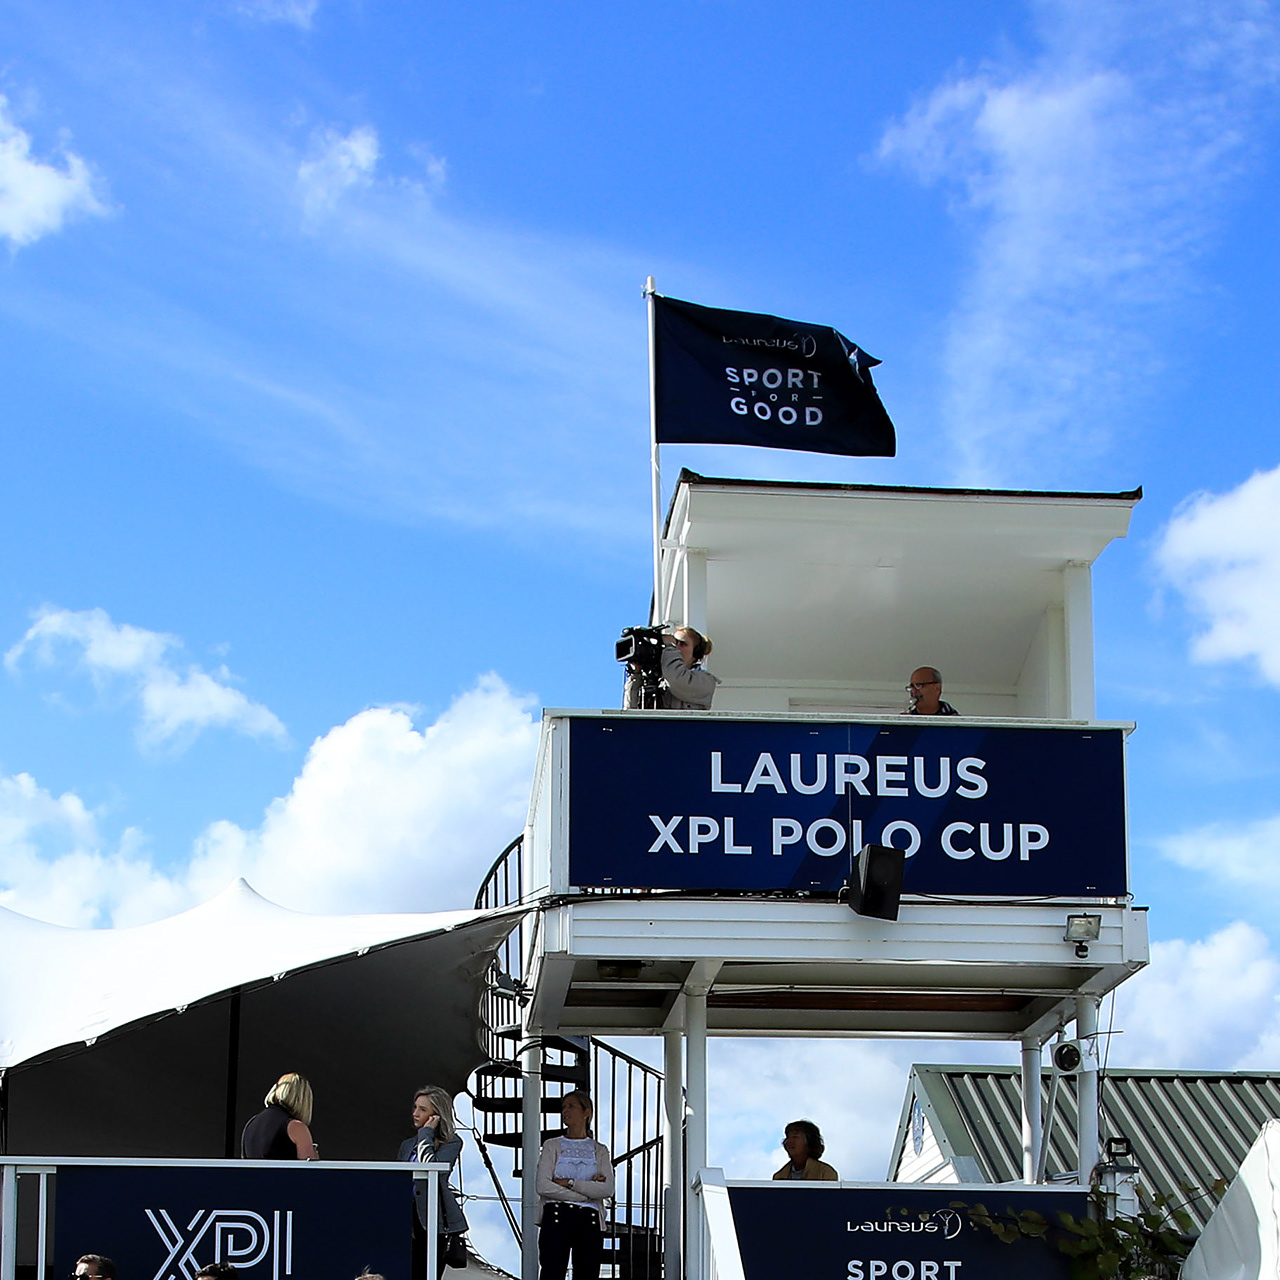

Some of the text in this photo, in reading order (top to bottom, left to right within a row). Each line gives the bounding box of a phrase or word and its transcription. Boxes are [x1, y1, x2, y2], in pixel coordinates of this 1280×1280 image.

[725, 366, 822, 389] SPORT
[730, 396, 823, 426] GOOD
[751, 390, 799, 402] FOR
[711, 751, 989, 799] LAUREUS
[647, 815, 752, 855] XPL
[940, 821, 1050, 861] CUP
